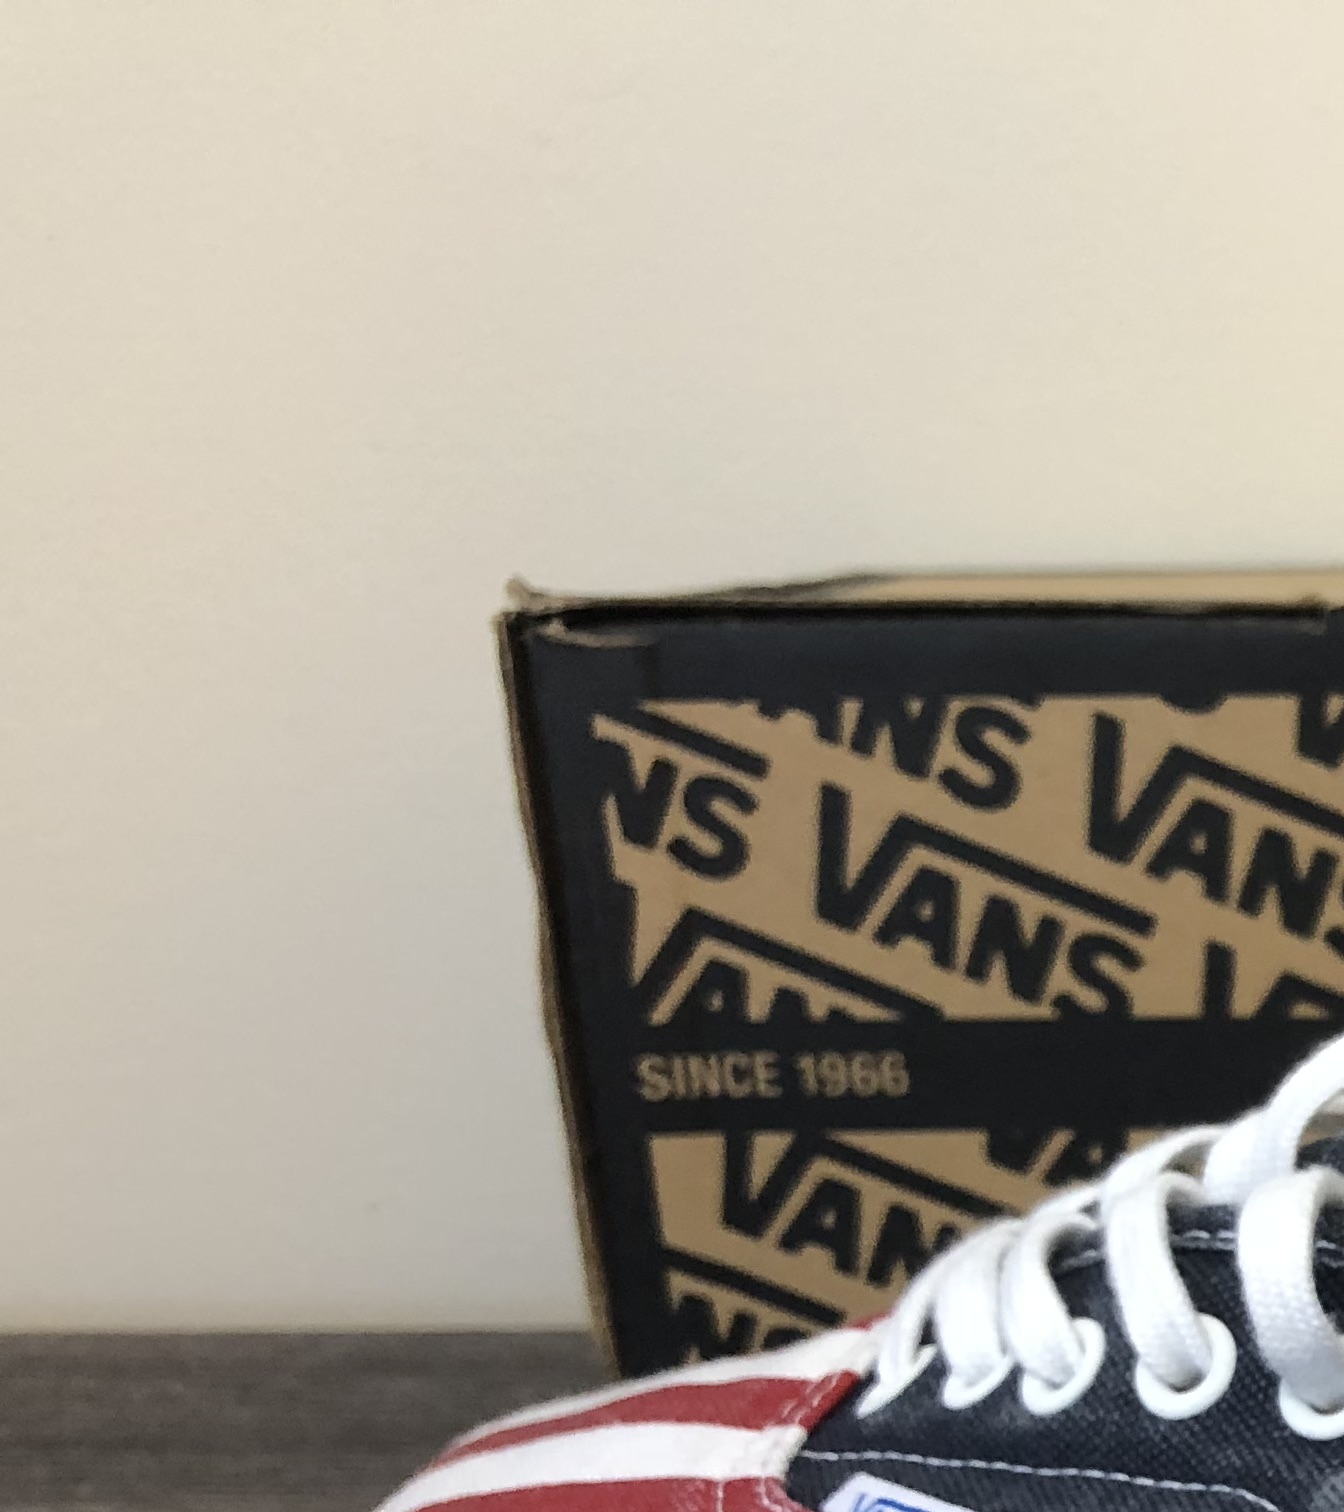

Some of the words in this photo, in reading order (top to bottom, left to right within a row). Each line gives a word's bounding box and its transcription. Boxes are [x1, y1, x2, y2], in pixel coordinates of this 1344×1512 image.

[597, 712, 770, 880] NS
[814, 782, 1158, 1020] VANS
[637, 1053, 782, 1101] SINCE
[797, 1052, 910, 1097] 1966
